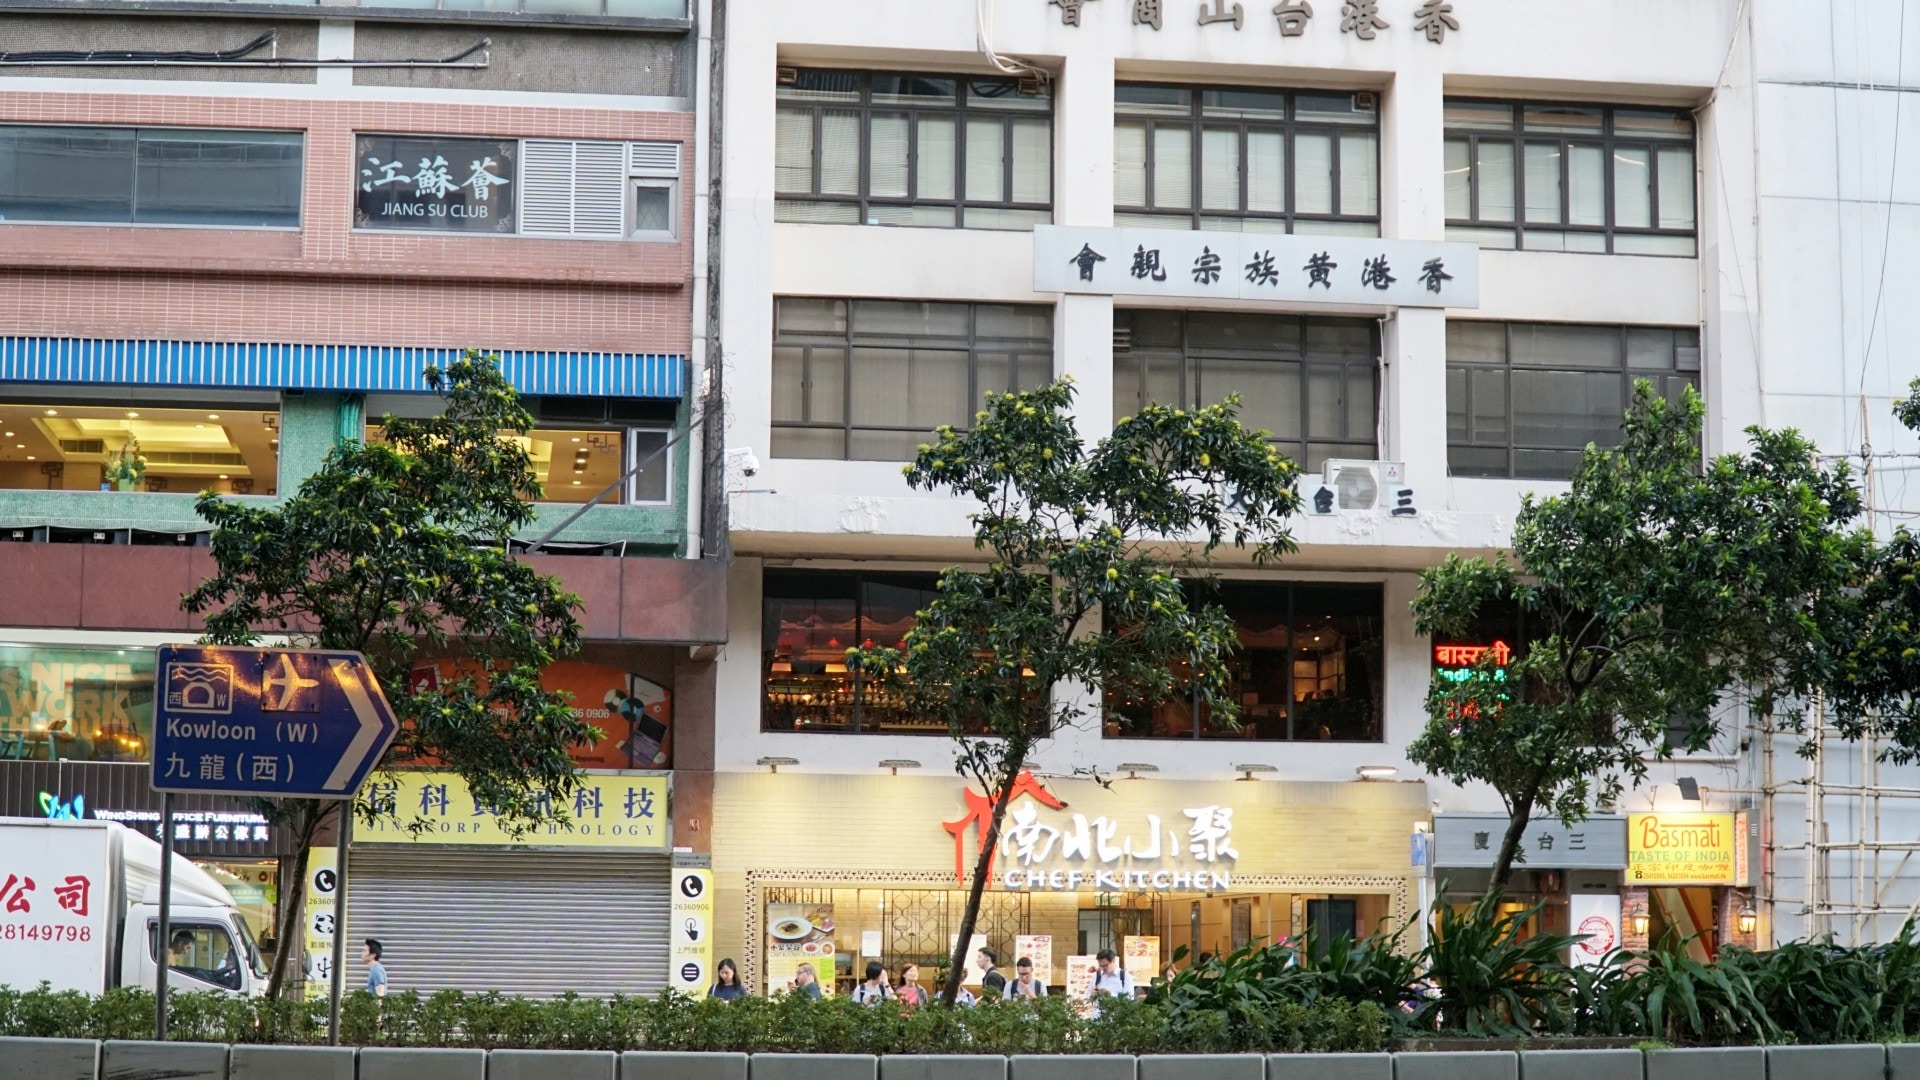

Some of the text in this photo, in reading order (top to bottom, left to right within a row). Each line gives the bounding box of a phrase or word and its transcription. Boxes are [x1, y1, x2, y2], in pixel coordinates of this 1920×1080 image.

[381, 202, 488, 218] JIANG SU CLUB
[169, 691, 182, 706] 西
[216, 693, 227, 707] W
[586, 709, 610, 720] 0906
[166, 718, 318, 744] Kowloon (W)
[172, 812, 204, 823] FFICE
[1001, 801, 1240, 867] 南北小聚
[1639, 816, 1721, 849] Basmati
[1630, 850, 1730, 861] TASTE OF INDIA
[1004, 869, 1229, 890] CHEF KITCHEN
[0, 873, 91, 917] 公司
[673, 903, 710, 911] 26360906
[0, 923, 91, 942] 8149798
